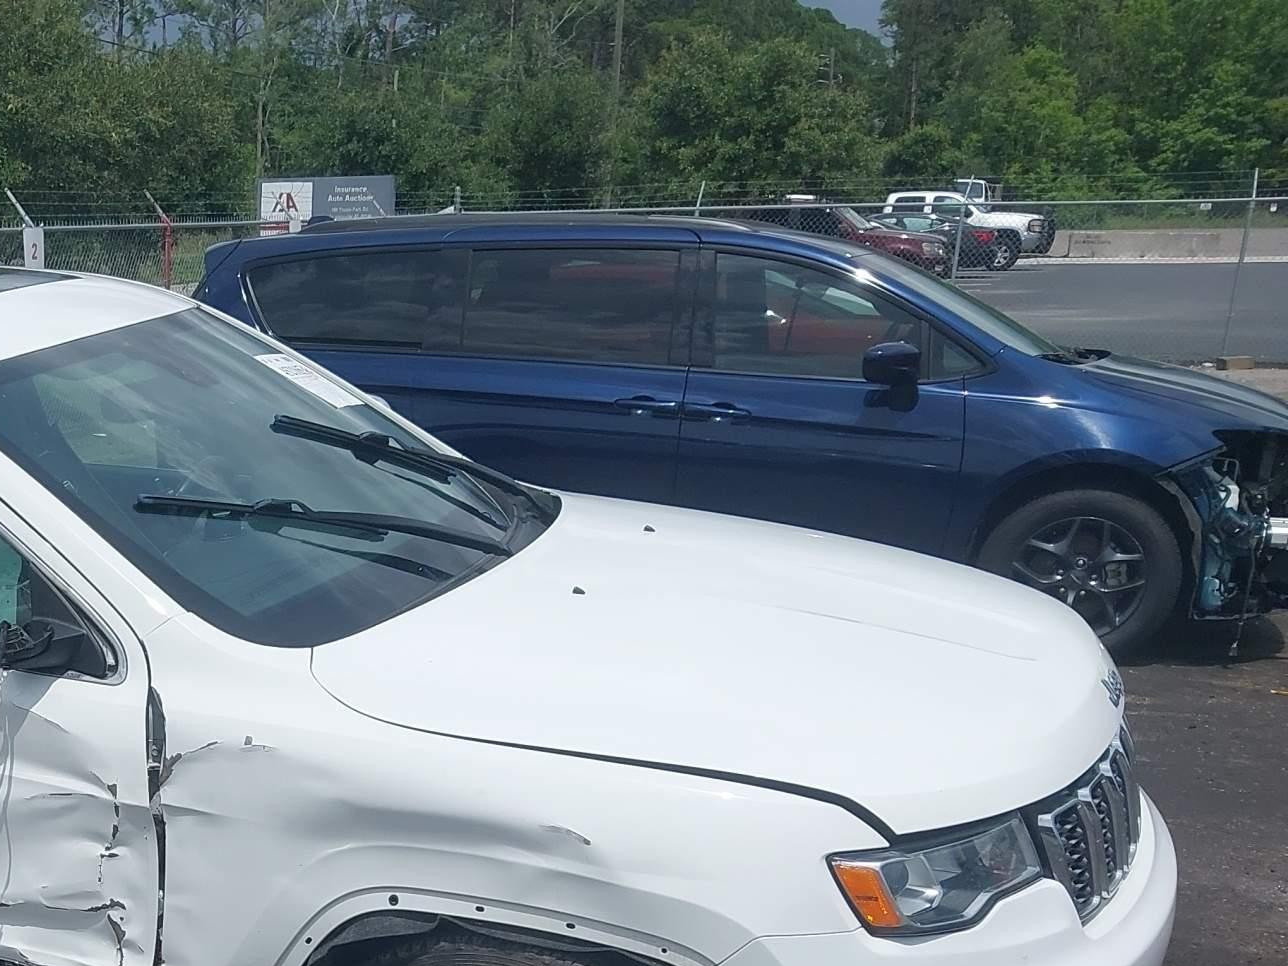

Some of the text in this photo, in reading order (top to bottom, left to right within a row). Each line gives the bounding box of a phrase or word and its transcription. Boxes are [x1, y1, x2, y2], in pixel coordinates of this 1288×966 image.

[334, 185, 367, 193] Insurance
[328, 194, 343, 202] Auto
[31, 242, 38, 261] 2
